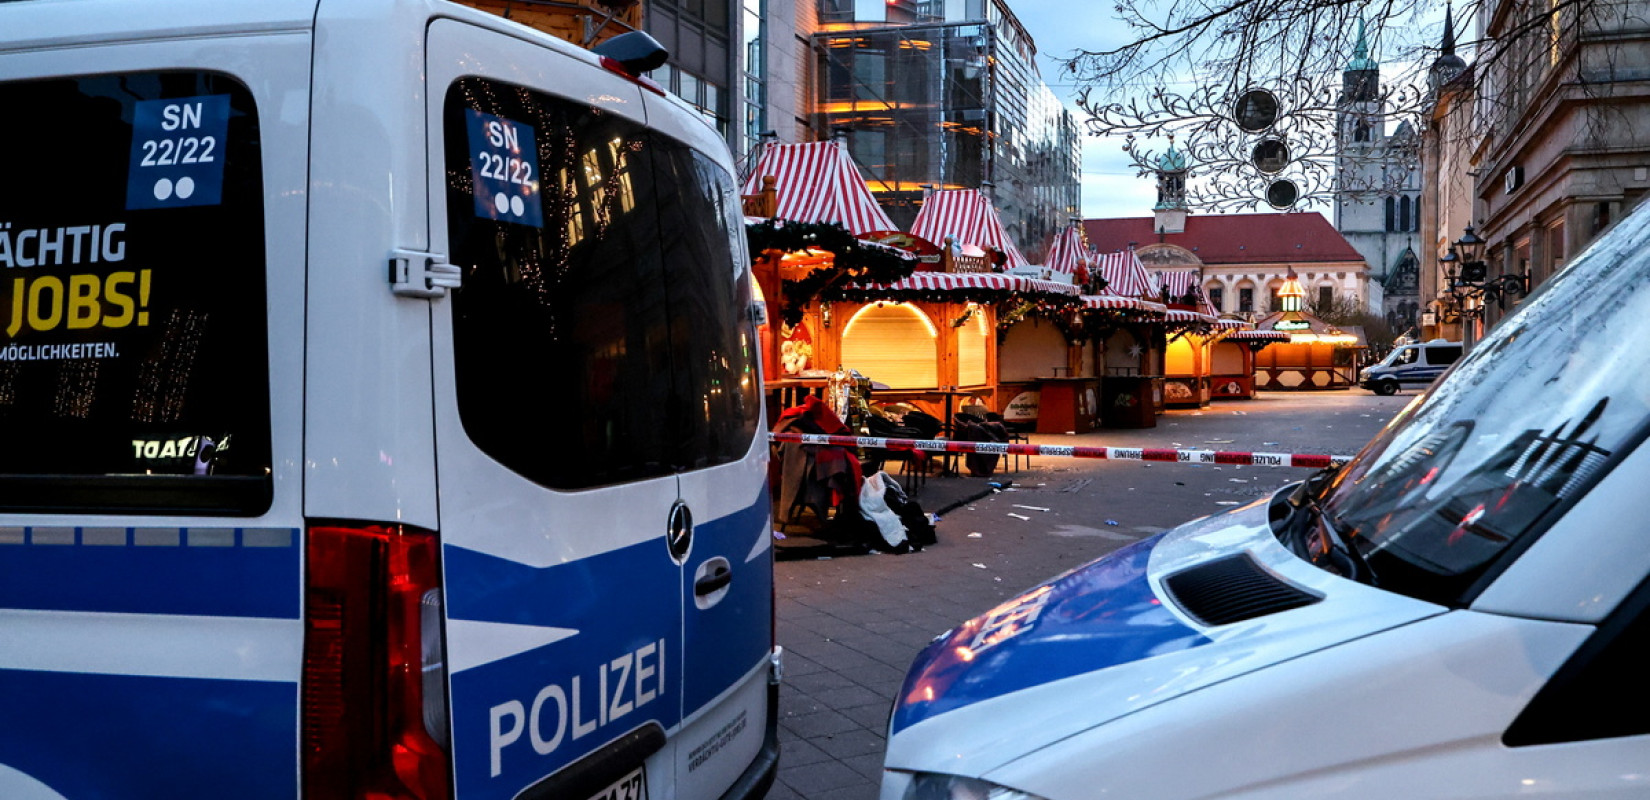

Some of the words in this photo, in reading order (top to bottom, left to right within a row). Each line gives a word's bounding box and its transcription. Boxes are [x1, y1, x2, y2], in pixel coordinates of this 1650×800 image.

[161, 102, 203, 131] SN
[140, 136, 216, 167] 22/22
[488, 120, 519, 152] SN
[479, 151, 534, 187] 22/22
[6, 268, 152, 338] JOBS!
[489, 637, 665, 779] POLIZEI
